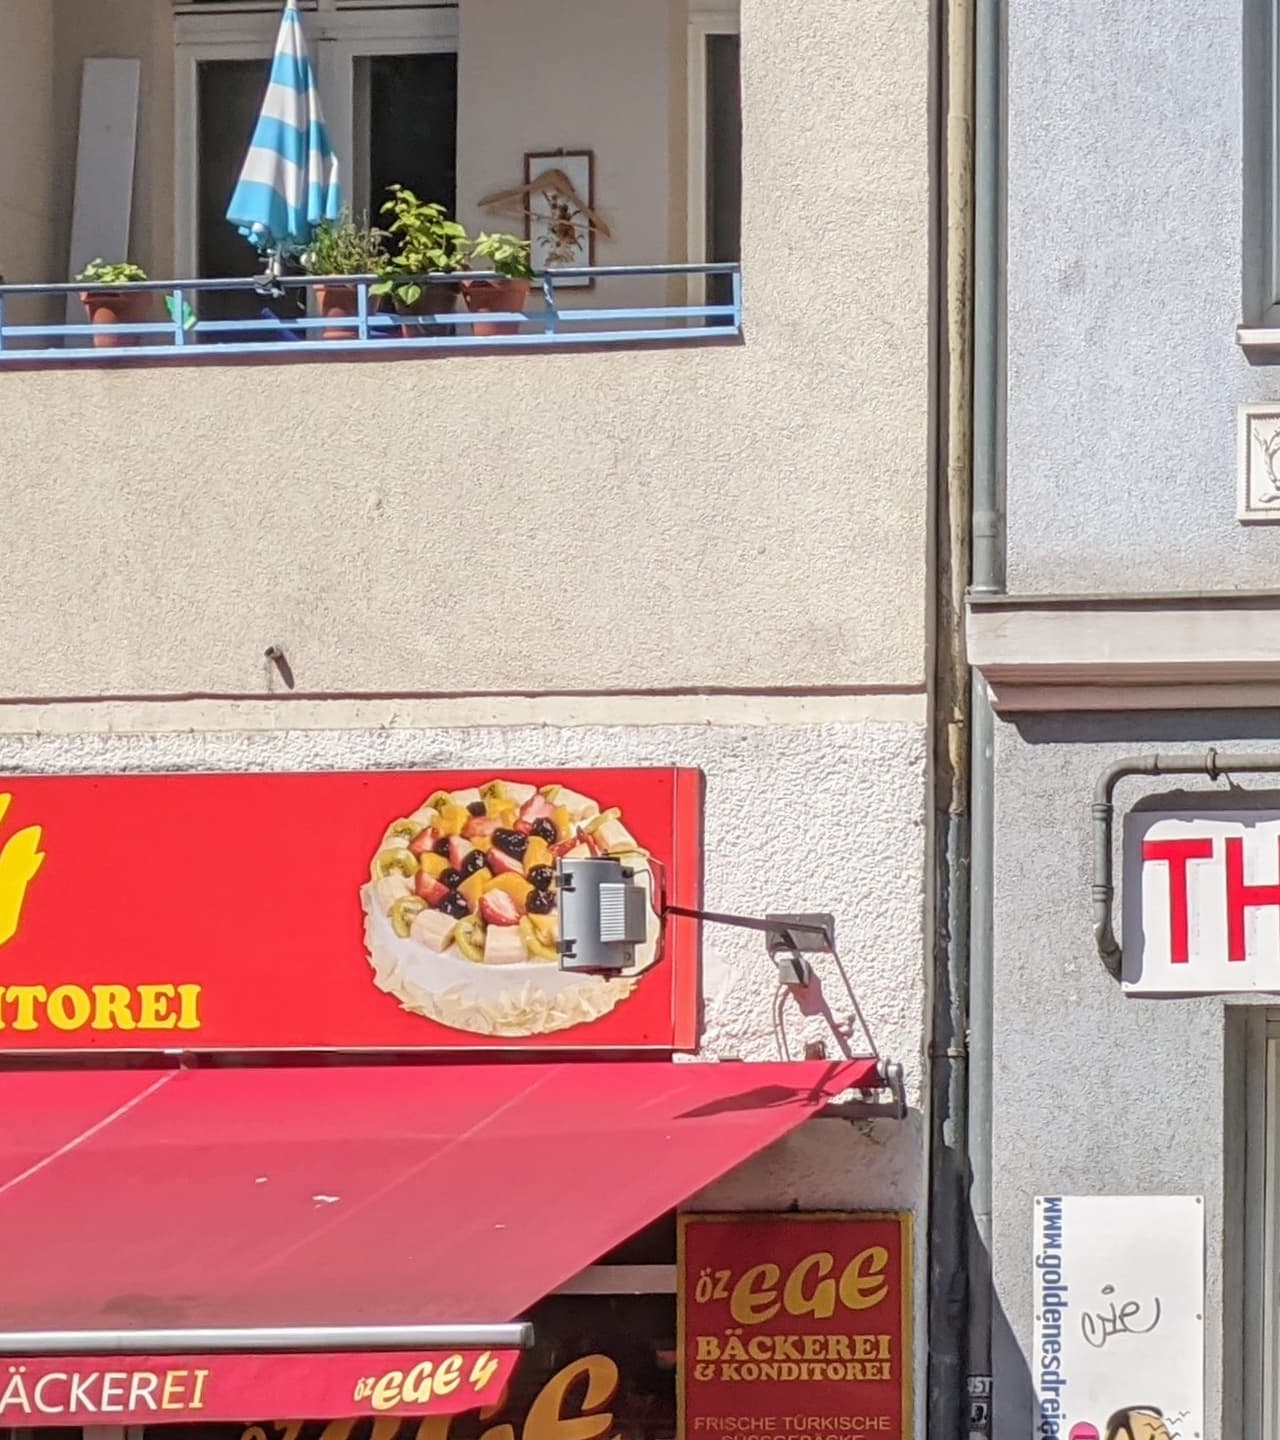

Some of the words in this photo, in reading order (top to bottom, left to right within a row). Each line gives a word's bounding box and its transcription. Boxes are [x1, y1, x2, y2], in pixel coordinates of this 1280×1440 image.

[0, 983, 202, 1031] TOREI
[730, 1246, 889, 1325] EGE
[696, 1328, 892, 1361] BÄCKEREI
[371, 1354, 464, 1410] EGE
[694, 1363, 716, 1381] &
[720, 1362, 892, 1381] KONDITOREI
[694, 1416, 777, 1431] FRISCHE
[782, 1413, 891, 1431] TÜRKISCHE
